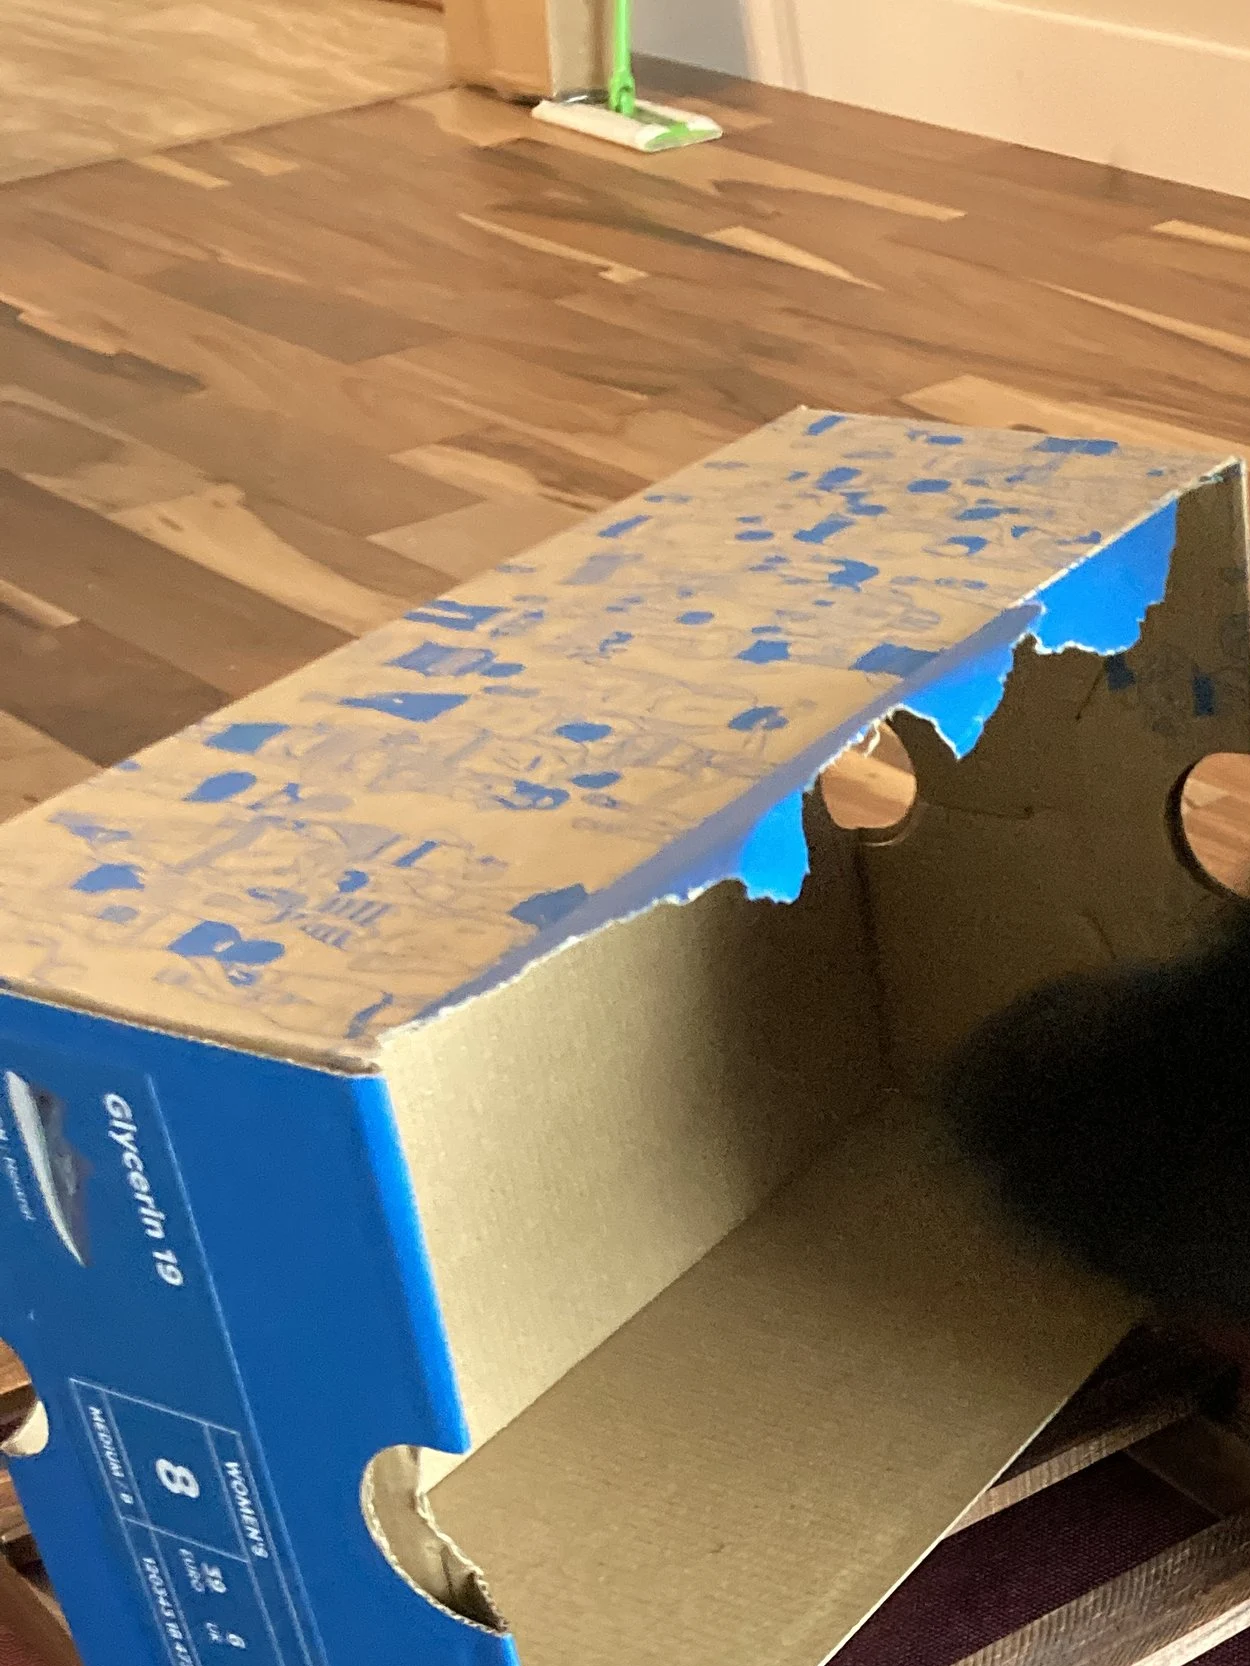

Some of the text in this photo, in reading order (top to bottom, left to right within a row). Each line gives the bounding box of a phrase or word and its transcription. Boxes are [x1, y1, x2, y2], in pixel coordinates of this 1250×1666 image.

[103, 1093, 184, 1286] Glycerin 19
[89, 1405, 125, 1478] MEDIUM
[155, 1457, 201, 1499] 8
[224, 1461, 269, 1559] WOMEN'S
[178, 1548, 206, 1593] EURO
[206, 1620, 223, 1643] UK
